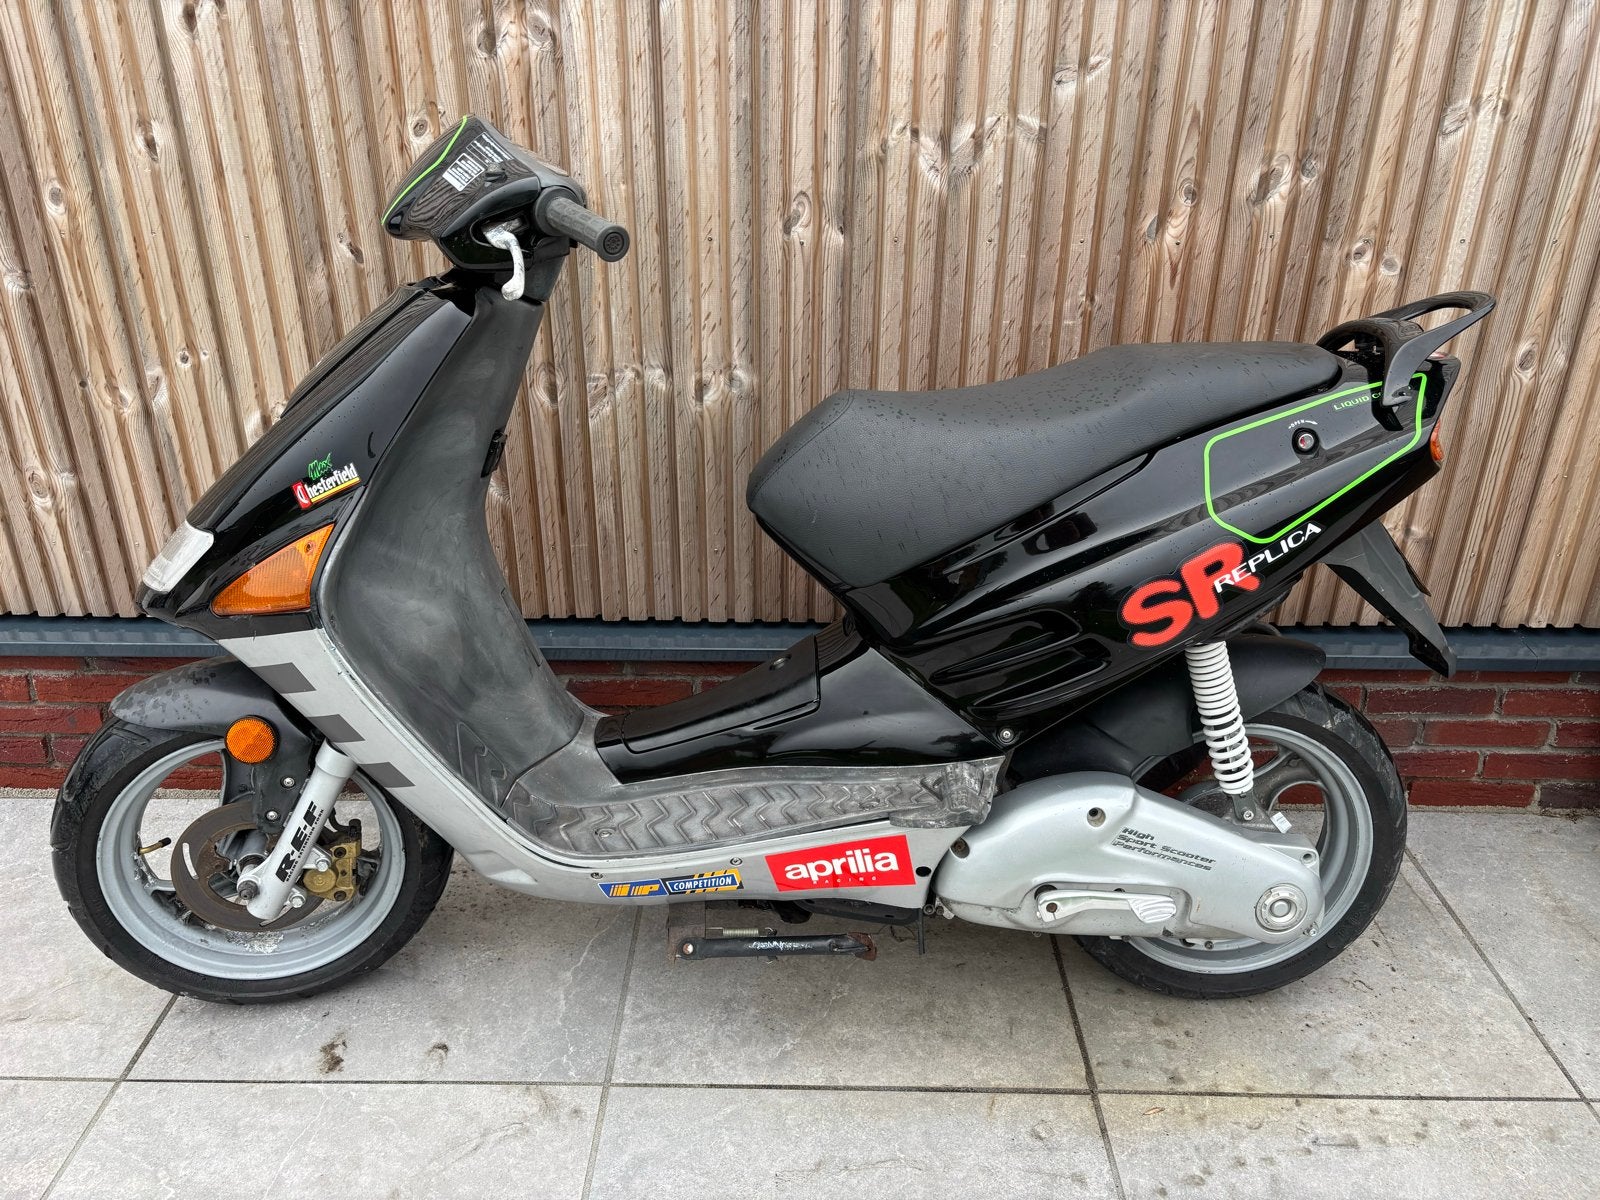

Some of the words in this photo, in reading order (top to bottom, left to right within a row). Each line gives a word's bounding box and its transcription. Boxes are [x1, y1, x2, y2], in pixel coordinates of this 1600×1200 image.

[1333, 395, 1370, 411] LIQUID
[297, 462, 358, 504] Chesterfield
[1213, 522, 1322, 594] REPLICA
[1120, 541, 1260, 647] SR
[1117, 834, 1157, 849] Sport
[1160, 845, 1216, 864] Scooter
[1121, 827, 1155, 841] High
[784, 848, 899, 881] aprilia
[1112, 840, 1212, 871] Performances
[673, 876, 732, 891] COMPETITION
